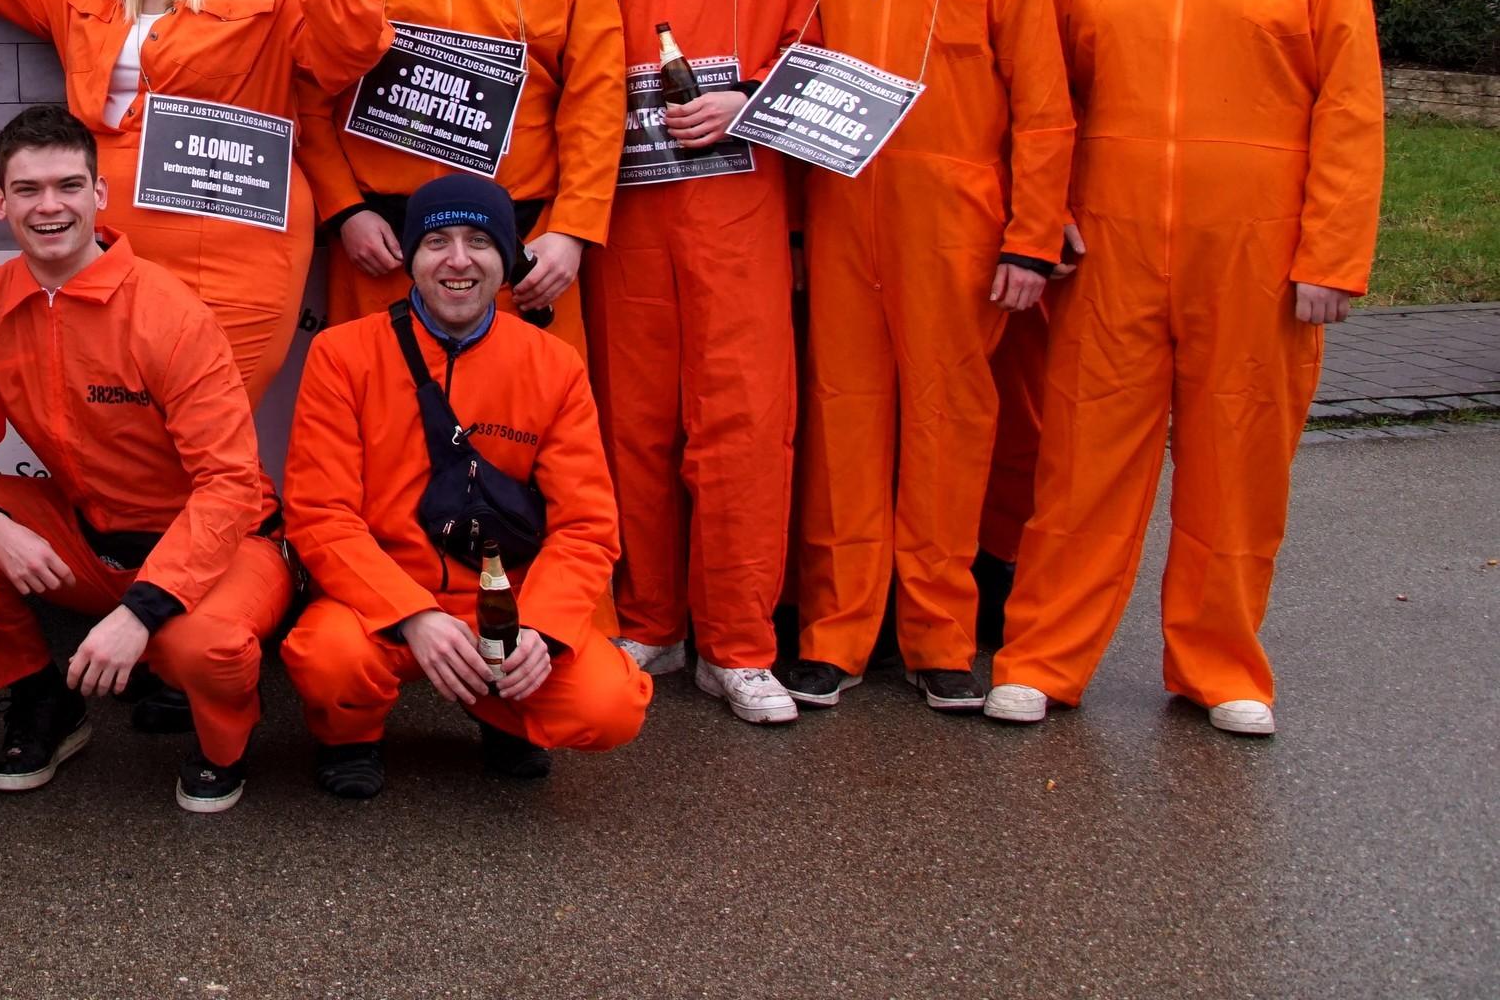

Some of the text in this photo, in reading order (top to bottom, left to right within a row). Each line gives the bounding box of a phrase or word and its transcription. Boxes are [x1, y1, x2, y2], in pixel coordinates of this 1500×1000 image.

[414, 45, 519, 83] JUSTIZVOLLZUGSANSTALT
[788, 55, 910, 104] MUHRER JUSTIZVOLLZUGSANSTALT
[410, 65, 471, 102] SEXUAL
[801, 78, 861, 114] BERUFS
[153, 101, 289, 134] MUHRER JUSTIZVOLLZUGSANSTALT
[387, 83, 487, 132] STRAFTÄTER
[769, 94, 868, 141] ALKOHOLIKER
[367, 105, 489, 153] Verbrechen: Vögelt alles und jeden
[654, 140, 667, 151] Hat
[819, 133, 843, 149] Woche
[187, 134, 254, 166] BLONDIE
[351, 120, 495, 172] 123456789012345678901234567890
[163, 162, 270, 189] Verbrechen: Hat die schönsten
[191, 179, 243, 196] blonden Haare
[140, 193, 284, 224] 123456789012345678901234567890
[424, 210, 489, 224] DEGENHART
[477, 422, 539, 446] 38750008
